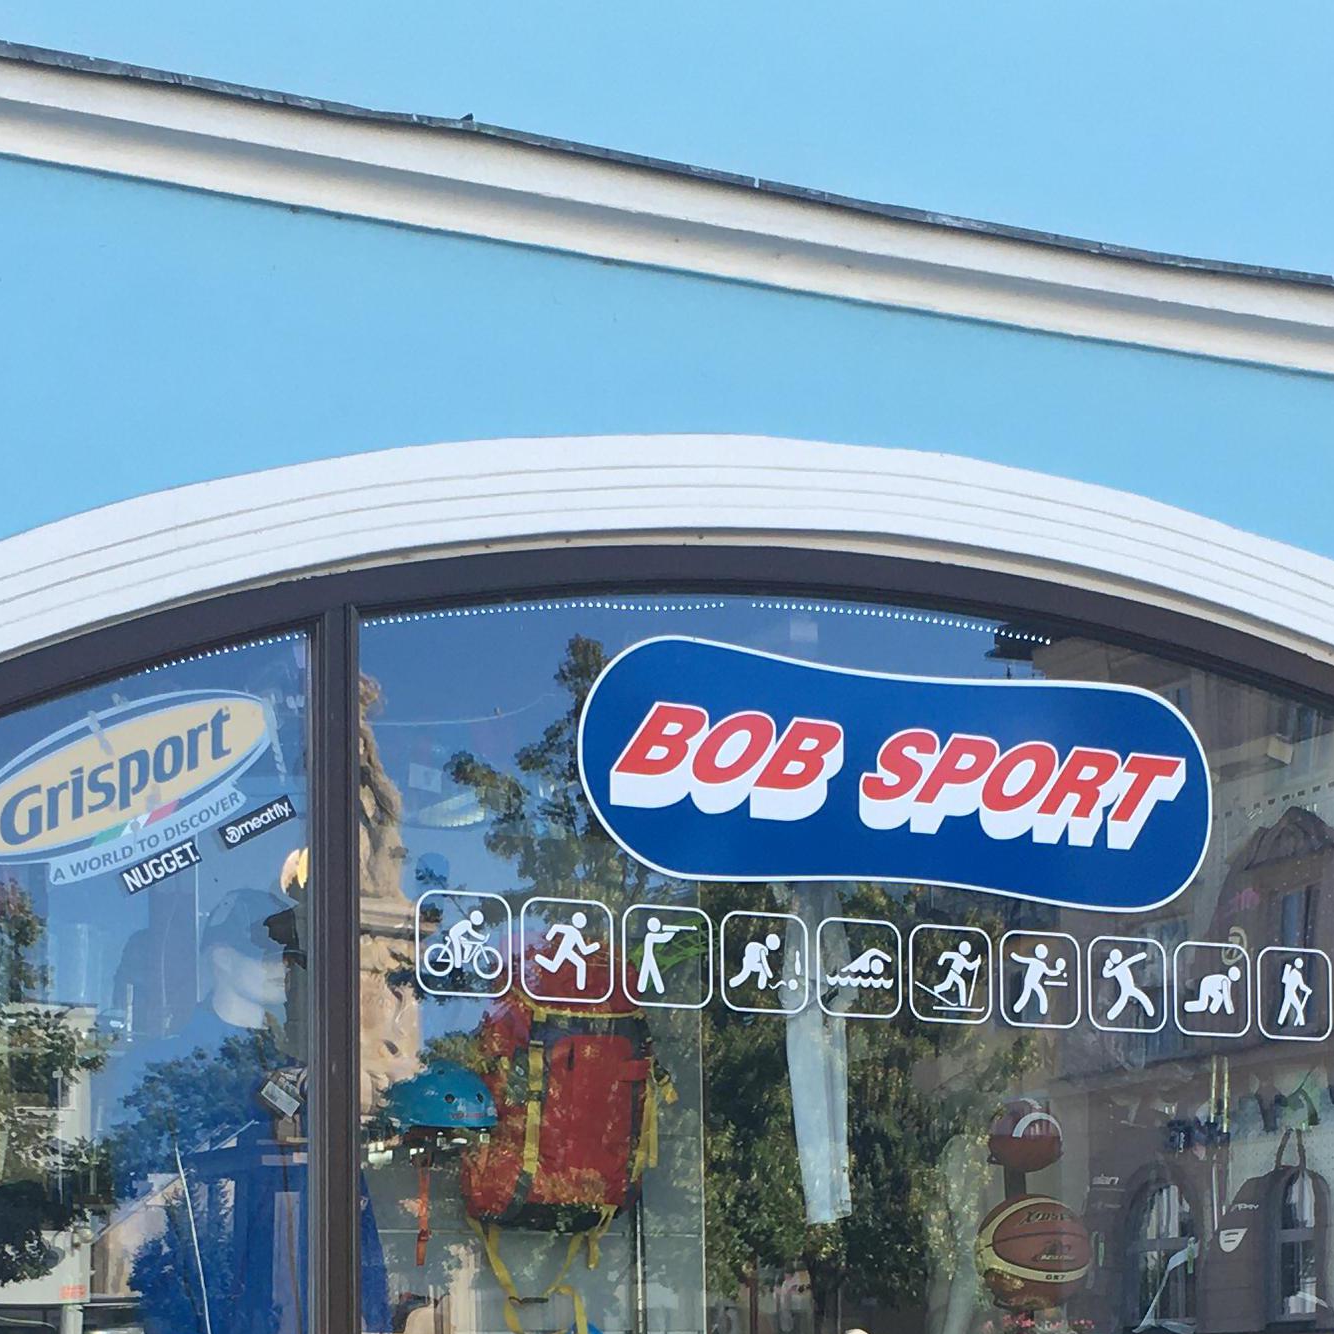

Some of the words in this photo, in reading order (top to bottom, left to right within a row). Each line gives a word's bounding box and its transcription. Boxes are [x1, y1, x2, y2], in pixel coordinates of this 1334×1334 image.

[52, 867, 66, 882] A
[70, 844, 134, 878] WORLD
[135, 834, 161, 856] TO
[163, 790, 241, 841] DISCOVER
[609, 701, 844, 822] BOB
[858, 727, 1186, 851] SPORT
